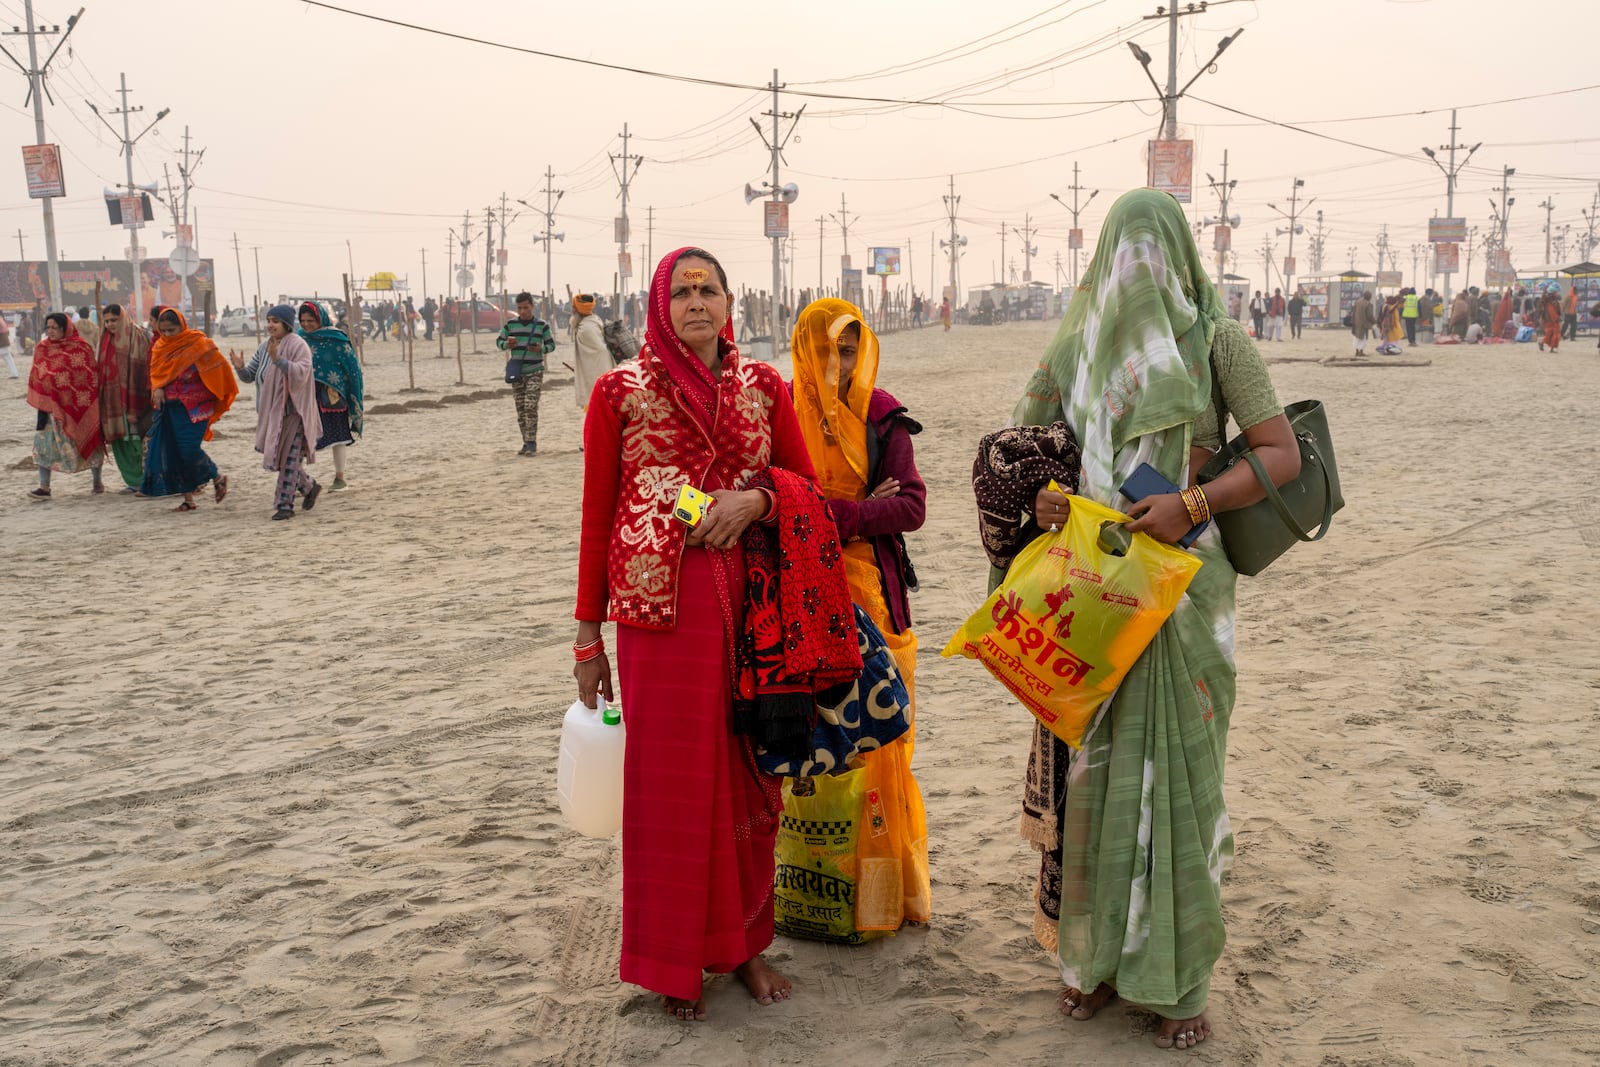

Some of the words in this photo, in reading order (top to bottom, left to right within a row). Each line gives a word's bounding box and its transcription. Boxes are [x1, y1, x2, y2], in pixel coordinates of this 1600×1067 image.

[982, 634, 1055, 697] गारमेन्ट्स
[991, 590, 1095, 687] फैशन
[807, 905, 842, 921] प्रसाद
